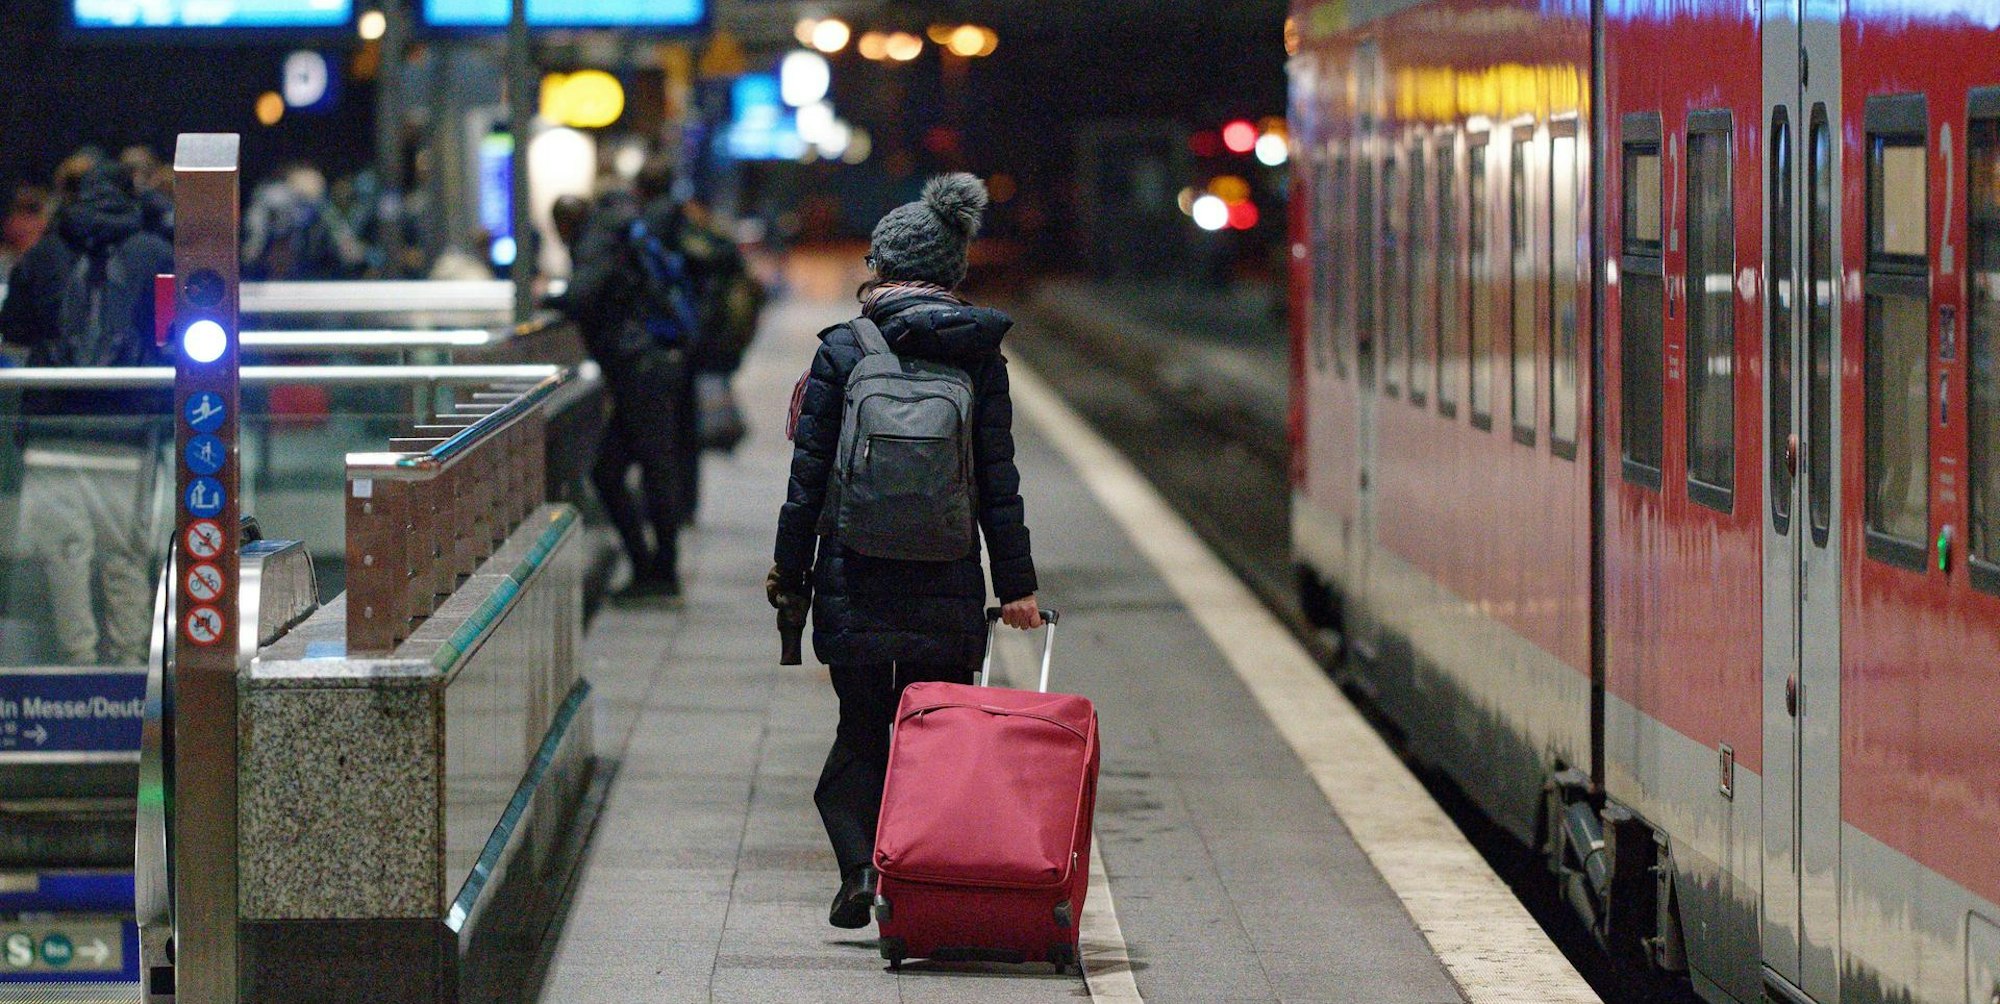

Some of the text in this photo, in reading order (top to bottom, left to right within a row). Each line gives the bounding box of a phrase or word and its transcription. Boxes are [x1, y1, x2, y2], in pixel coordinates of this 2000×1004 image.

[1669, 132, 1678, 252] 2
[1938, 122, 1954, 274] 2
[7, 933, 34, 967] S
